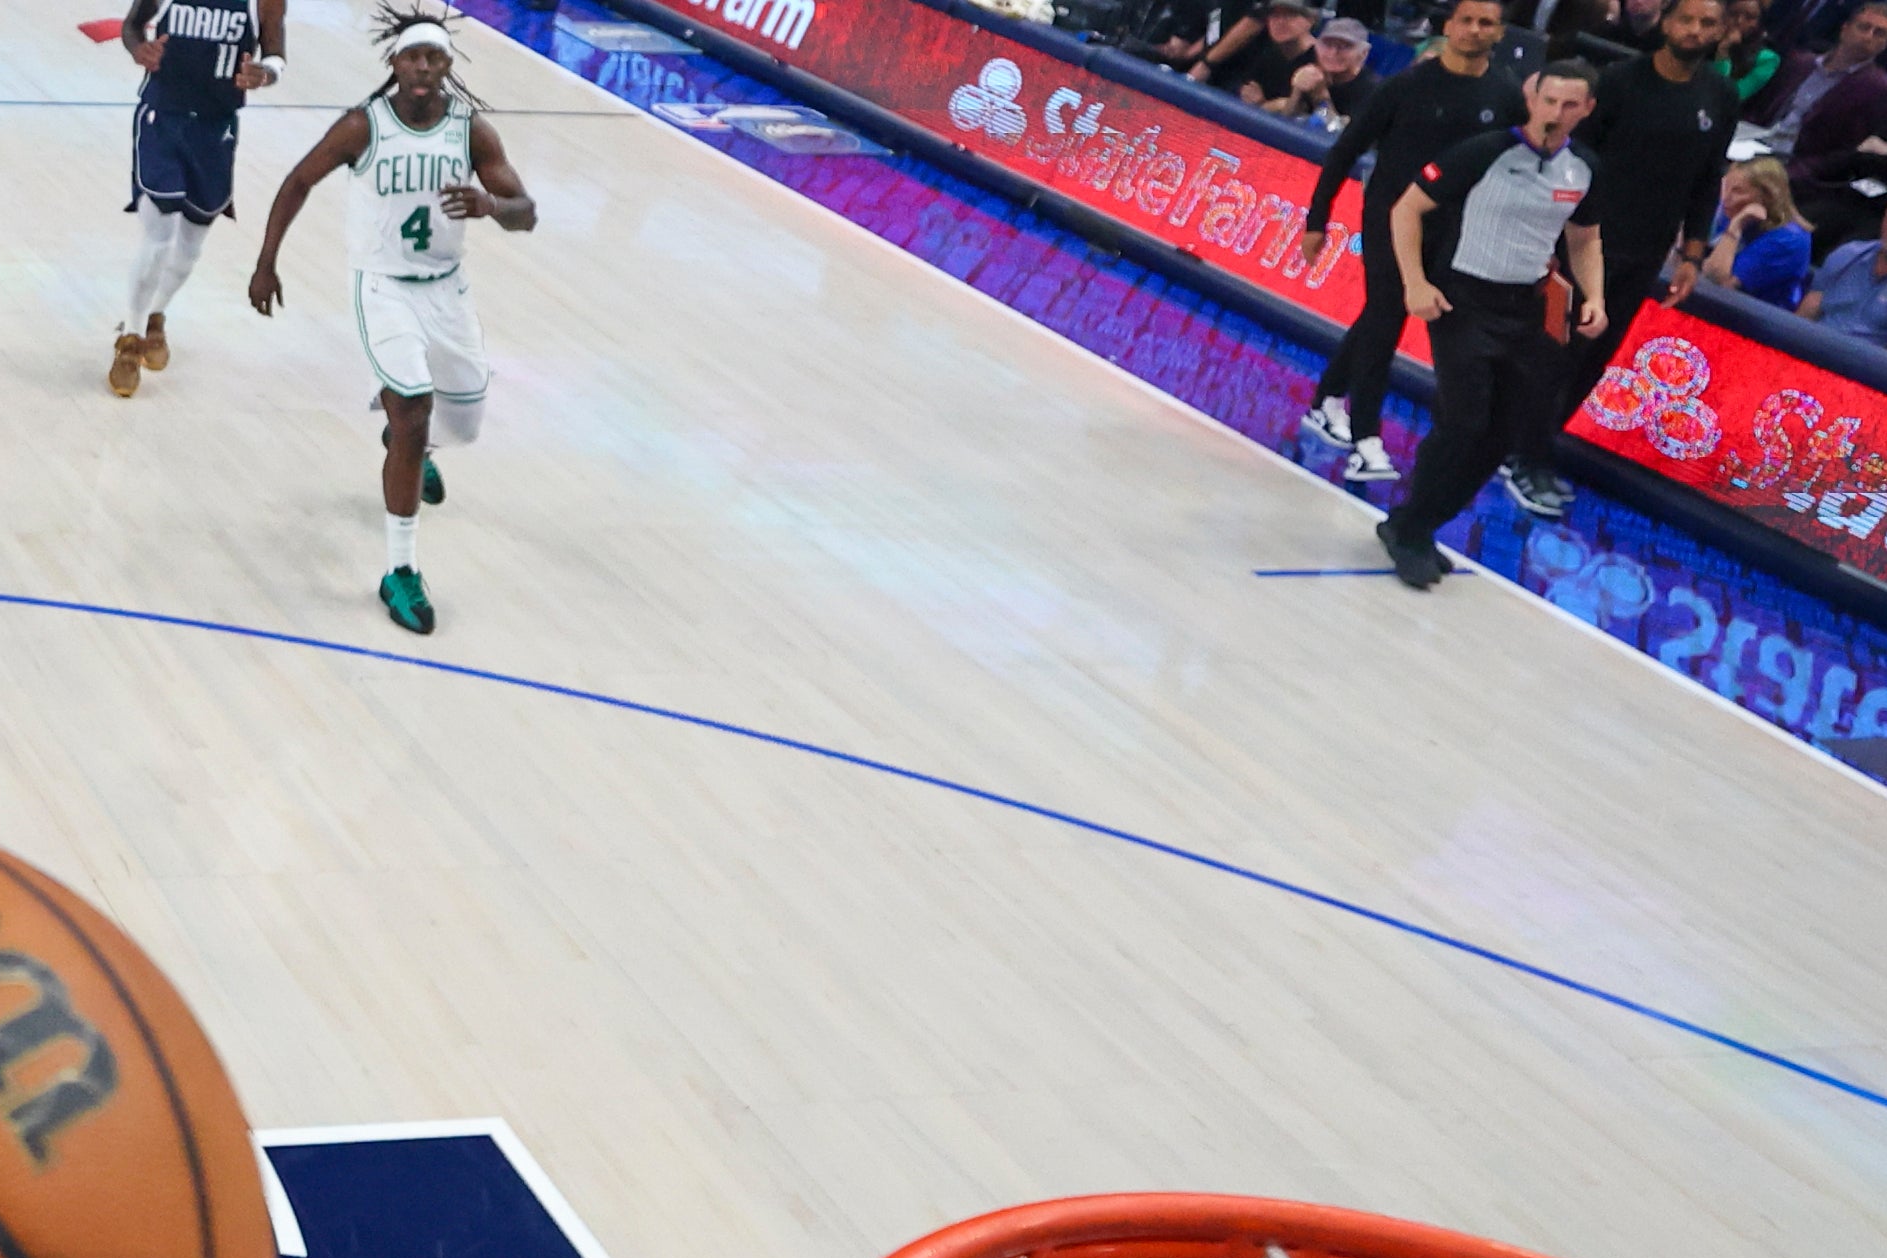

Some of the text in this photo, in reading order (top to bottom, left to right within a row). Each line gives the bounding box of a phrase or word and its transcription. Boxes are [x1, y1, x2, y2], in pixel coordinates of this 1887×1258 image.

[215, 43, 239, 79] 11
[376, 152, 462, 197] CELTICS
[400, 205, 432, 252] 4
